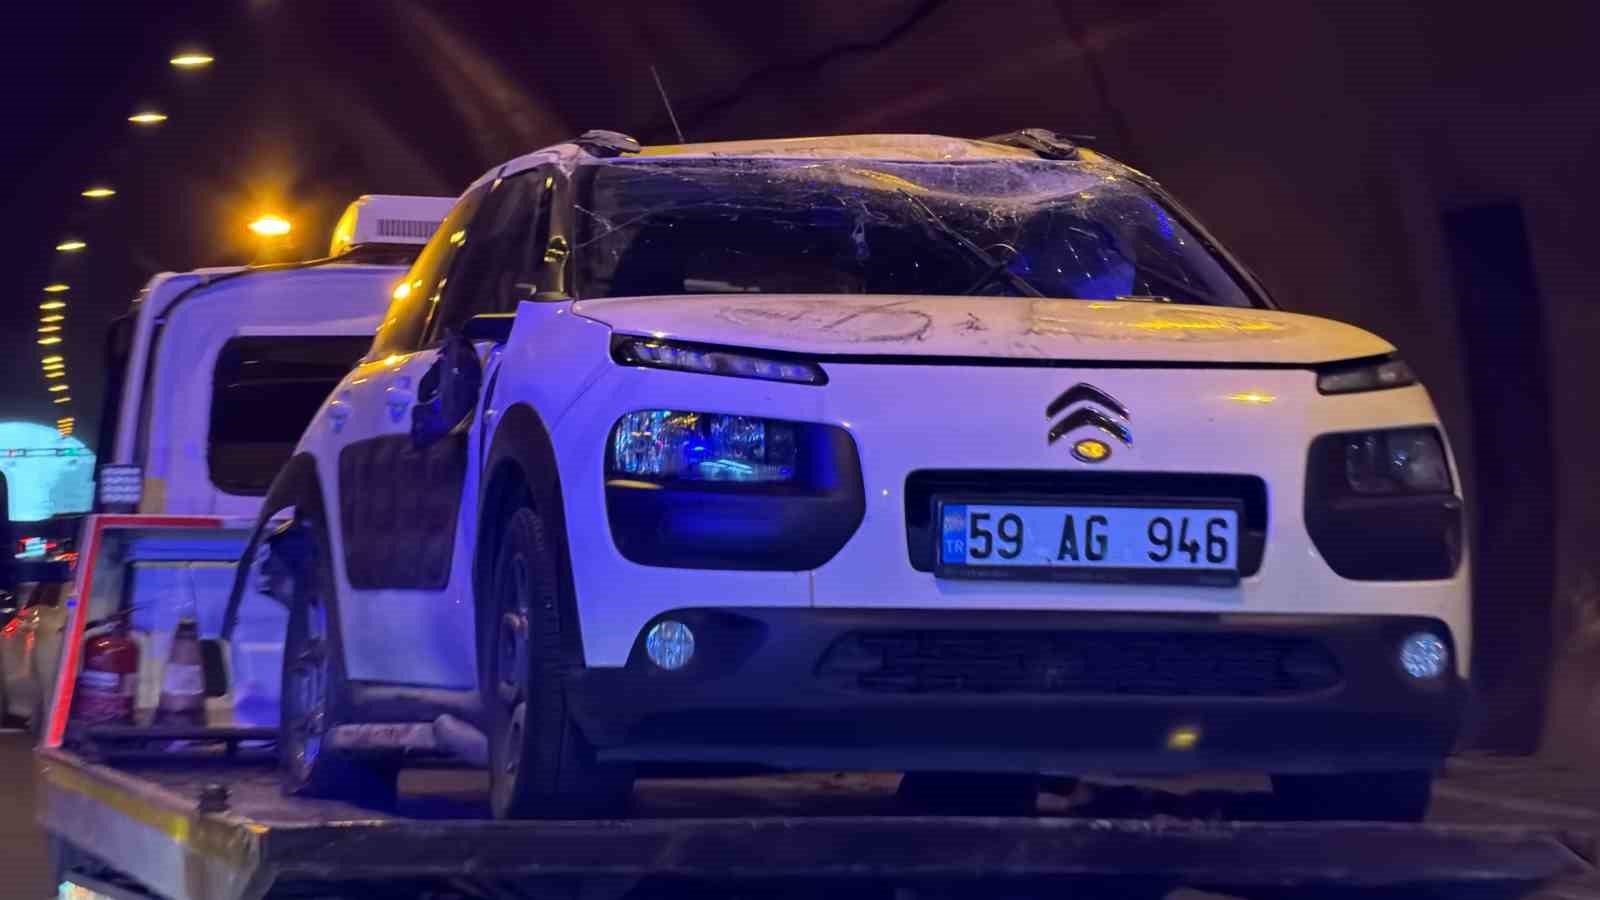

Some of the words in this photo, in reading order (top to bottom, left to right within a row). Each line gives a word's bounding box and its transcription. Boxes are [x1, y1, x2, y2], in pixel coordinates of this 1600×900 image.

[945, 540, 964, 553] TR
[969, 513, 1024, 559] 59
[1057, 514, 1109, 561] AG
[1147, 517, 1229, 564] 946
